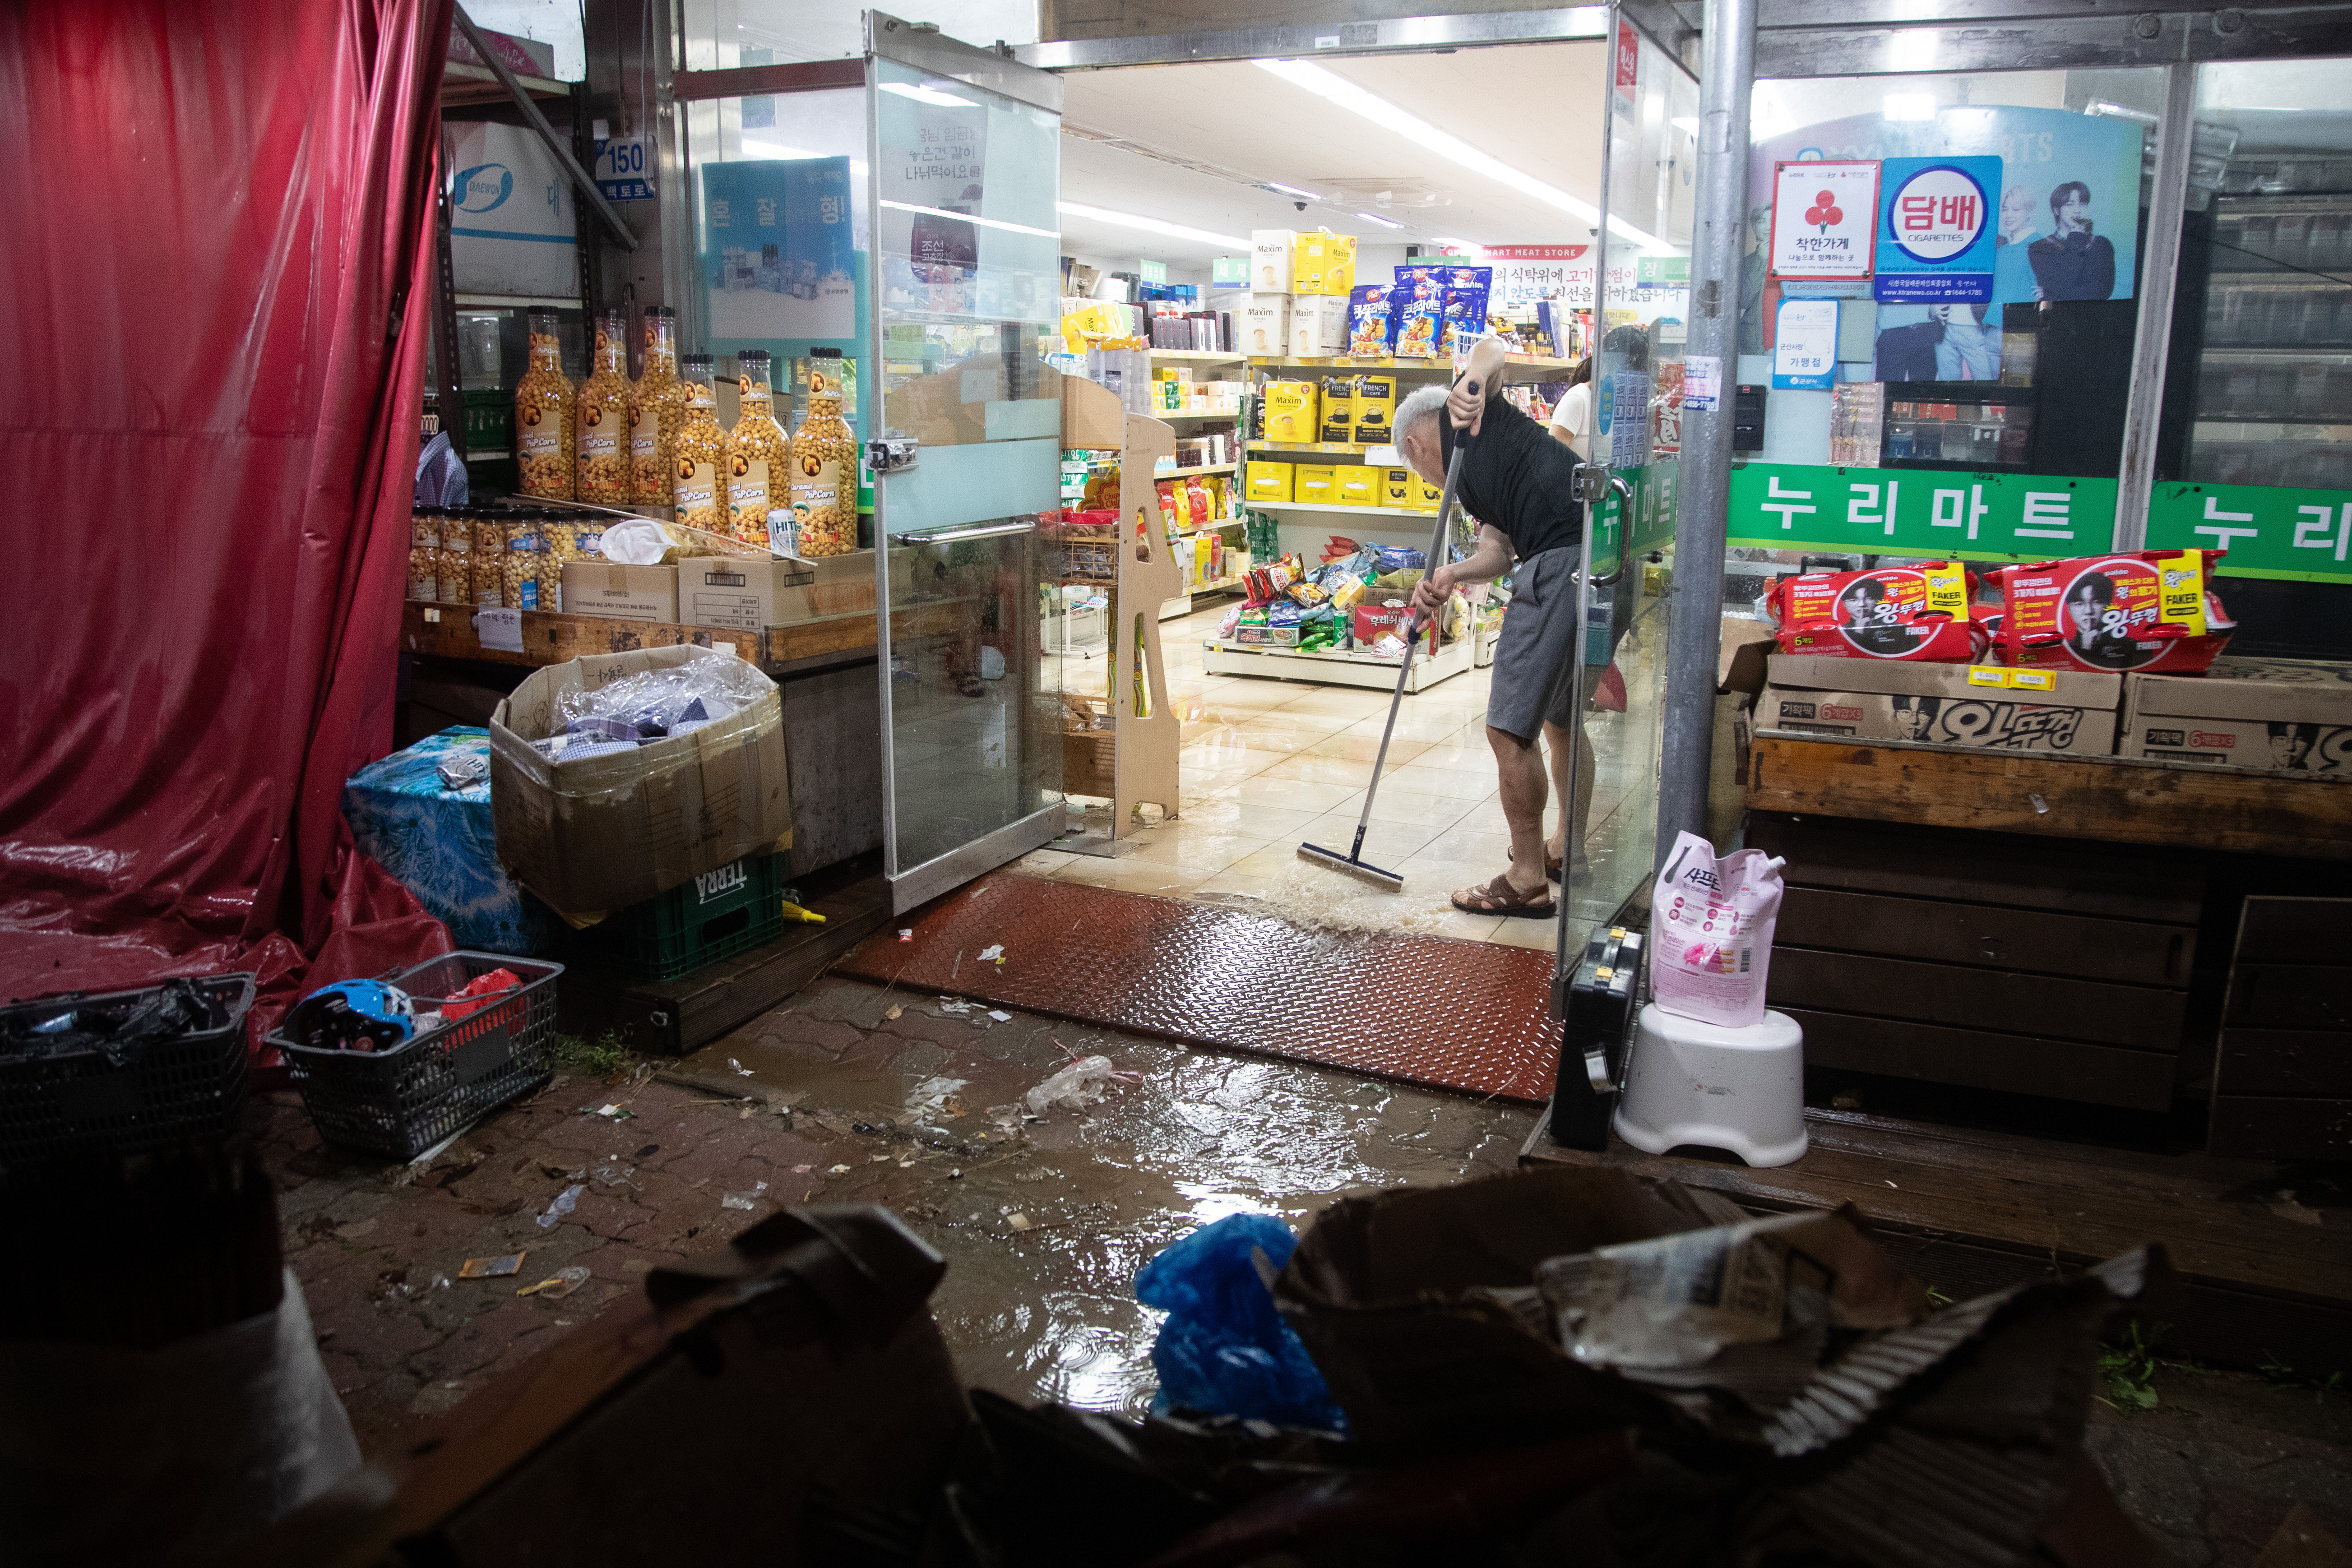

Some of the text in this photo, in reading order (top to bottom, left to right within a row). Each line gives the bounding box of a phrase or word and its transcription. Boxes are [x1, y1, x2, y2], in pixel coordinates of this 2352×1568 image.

[950, 145, 975, 160] 같이
[2001, 132, 2053, 164] BTS
[607, 143, 643, 174] 150
[468, 181, 500, 195] DAEWON
[606, 184, 645, 199] 백토로
[1902, 195, 1976, 231] 담배
[1796, 237, 1849, 251] 착한가게
[1908, 234, 1964, 242] CIGARETTES
[921, 240, 944, 252] 조선
[1257, 244, 1282, 252] Maxim
[1333, 249, 1350, 258] Maxim
[1515, 248, 1576, 257] MEAT STORE
[1218, 263, 1247, 278] 세제
[1511, 268, 1563, 283] 식탁위에
[1367, 291, 1379, 299] Post
[1511, 286, 1550, 300] 않도록
[1554, 286, 1594, 302] 최선을
[1247, 307, 1273, 316] Maxim
[1295, 308, 1314, 317] Maxim
[1403, 300, 1441, 319] 콘푸라이트
[1790, 357, 1821, 367] 가맹점
[1275, 395, 1301, 404] Maxim
[526, 438, 556, 447] PoPCorn
[791, 482, 814, 491] Caramel
[681, 491, 712, 502] PoPCorn
[734, 489, 764, 500] PoPCorn
[804, 489, 835, 499] PoPCorn
[1105, 490, 1119, 500] Chup
[1761, 476, 2074, 540] 누리마트
[2166, 593, 2198, 605] FAKER
[1874, 600, 1926, 624] 왕뚜껑
[2102, 607, 2159, 638] 왕뚜껑
[1905, 626, 1930, 636] FAKER
[1241, 633, 1260, 643] 육개장
[1795, 636, 1814, 646] 6개입
[2136, 641, 2163, 651] FAKER
[1782, 703, 1814, 717] 기획팩
[2148, 731, 2182, 744] 기획팩
[467, 758, 486, 774] HIT
[695, 860, 747, 898] TERRA
